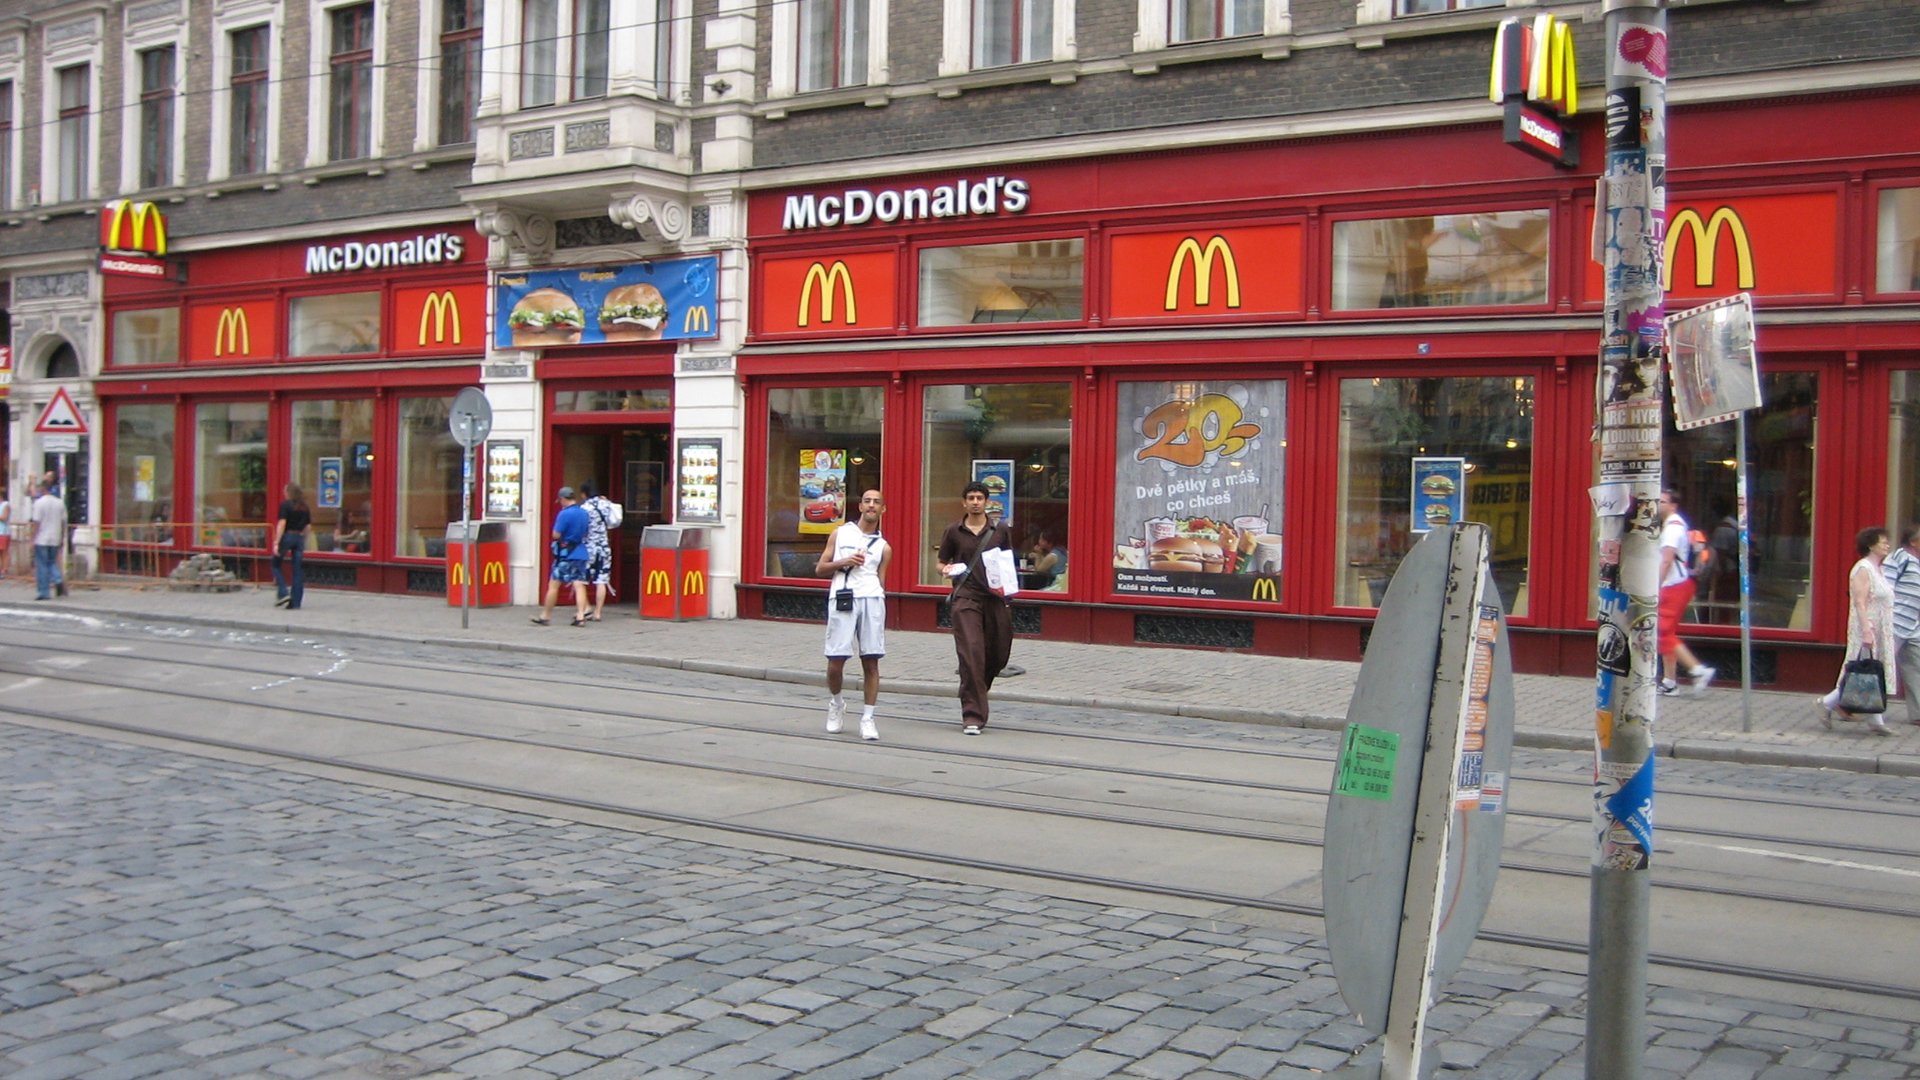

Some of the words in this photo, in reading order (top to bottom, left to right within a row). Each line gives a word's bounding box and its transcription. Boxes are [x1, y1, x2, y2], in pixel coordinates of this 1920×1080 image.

[782, 176, 1030, 232] McDonald's
[305, 232, 464, 275] McDonald's
[1136, 482, 1163, 500] Dvě
[1167, 477, 1207, 498] pětky
[1211, 478, 1221, 488] a
[1225, 471, 1260, 487] máš,
[1166, 500, 1185, 512] co
[1189, 491, 1231, 509] chceš
